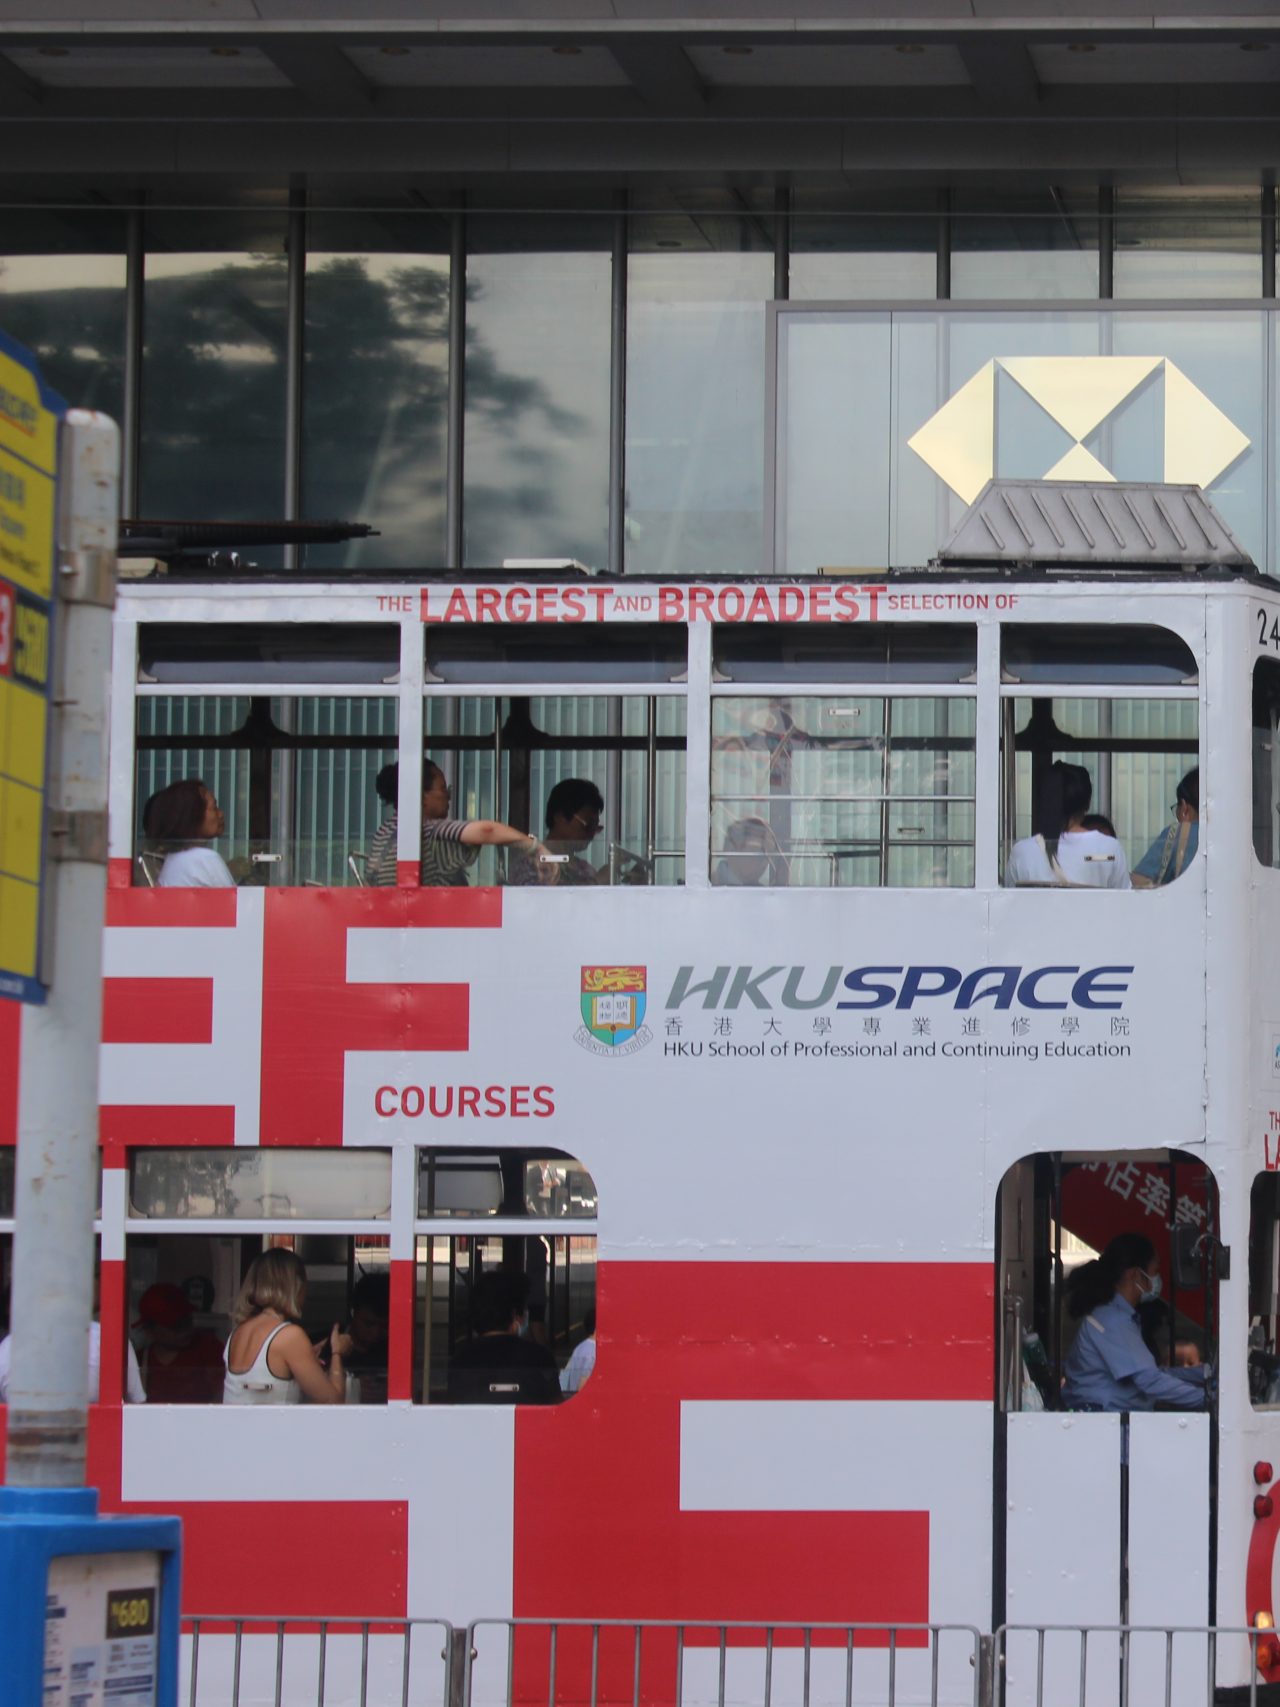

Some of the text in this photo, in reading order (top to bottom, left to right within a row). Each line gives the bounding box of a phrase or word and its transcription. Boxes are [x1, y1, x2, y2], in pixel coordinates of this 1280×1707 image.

[376, 586, 1019, 622] THE LARGEST AND BROADEST SELECTION OF
[1257, 608, 1280, 650] 24
[664, 1016, 1130, 1036] 香港大學專業進修學院
[664, 1041, 1130, 1060] HKU School of Professional and Continuing Education
[375, 1085, 556, 1117] COURSES
